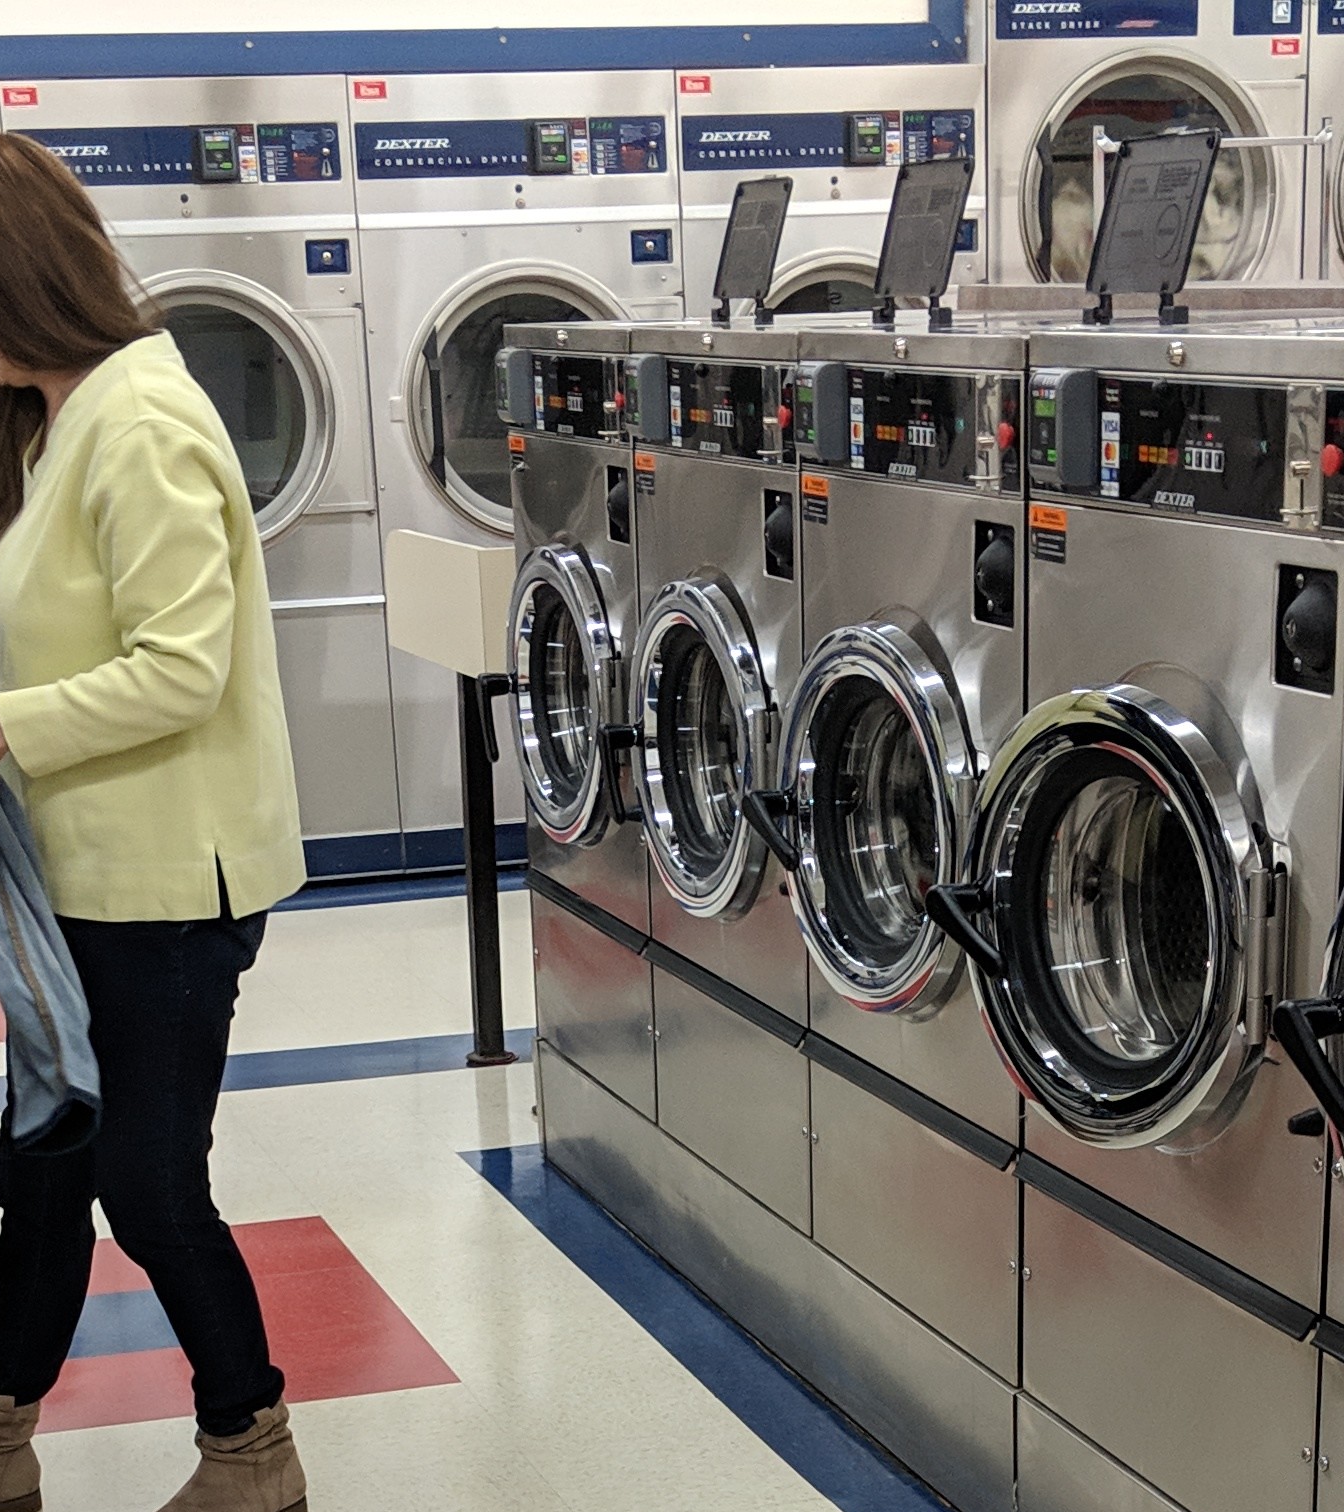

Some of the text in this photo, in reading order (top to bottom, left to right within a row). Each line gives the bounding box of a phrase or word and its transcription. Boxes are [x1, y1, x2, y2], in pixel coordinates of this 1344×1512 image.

[1012, 3, 1081, 14] DEXTER
[1011, 20, 1099, 30] STACK DRYER
[699, 131, 771, 142] DEXTER
[374, 138, 450, 149] DEXTER
[699, 146, 844, 158] COMMERCIAL DRYER
[374, 155, 528, 166] COMMERCIAL DRYER
[143, 162, 193, 172] DRYER
[1154, 491, 1195, 507] DEXTER
